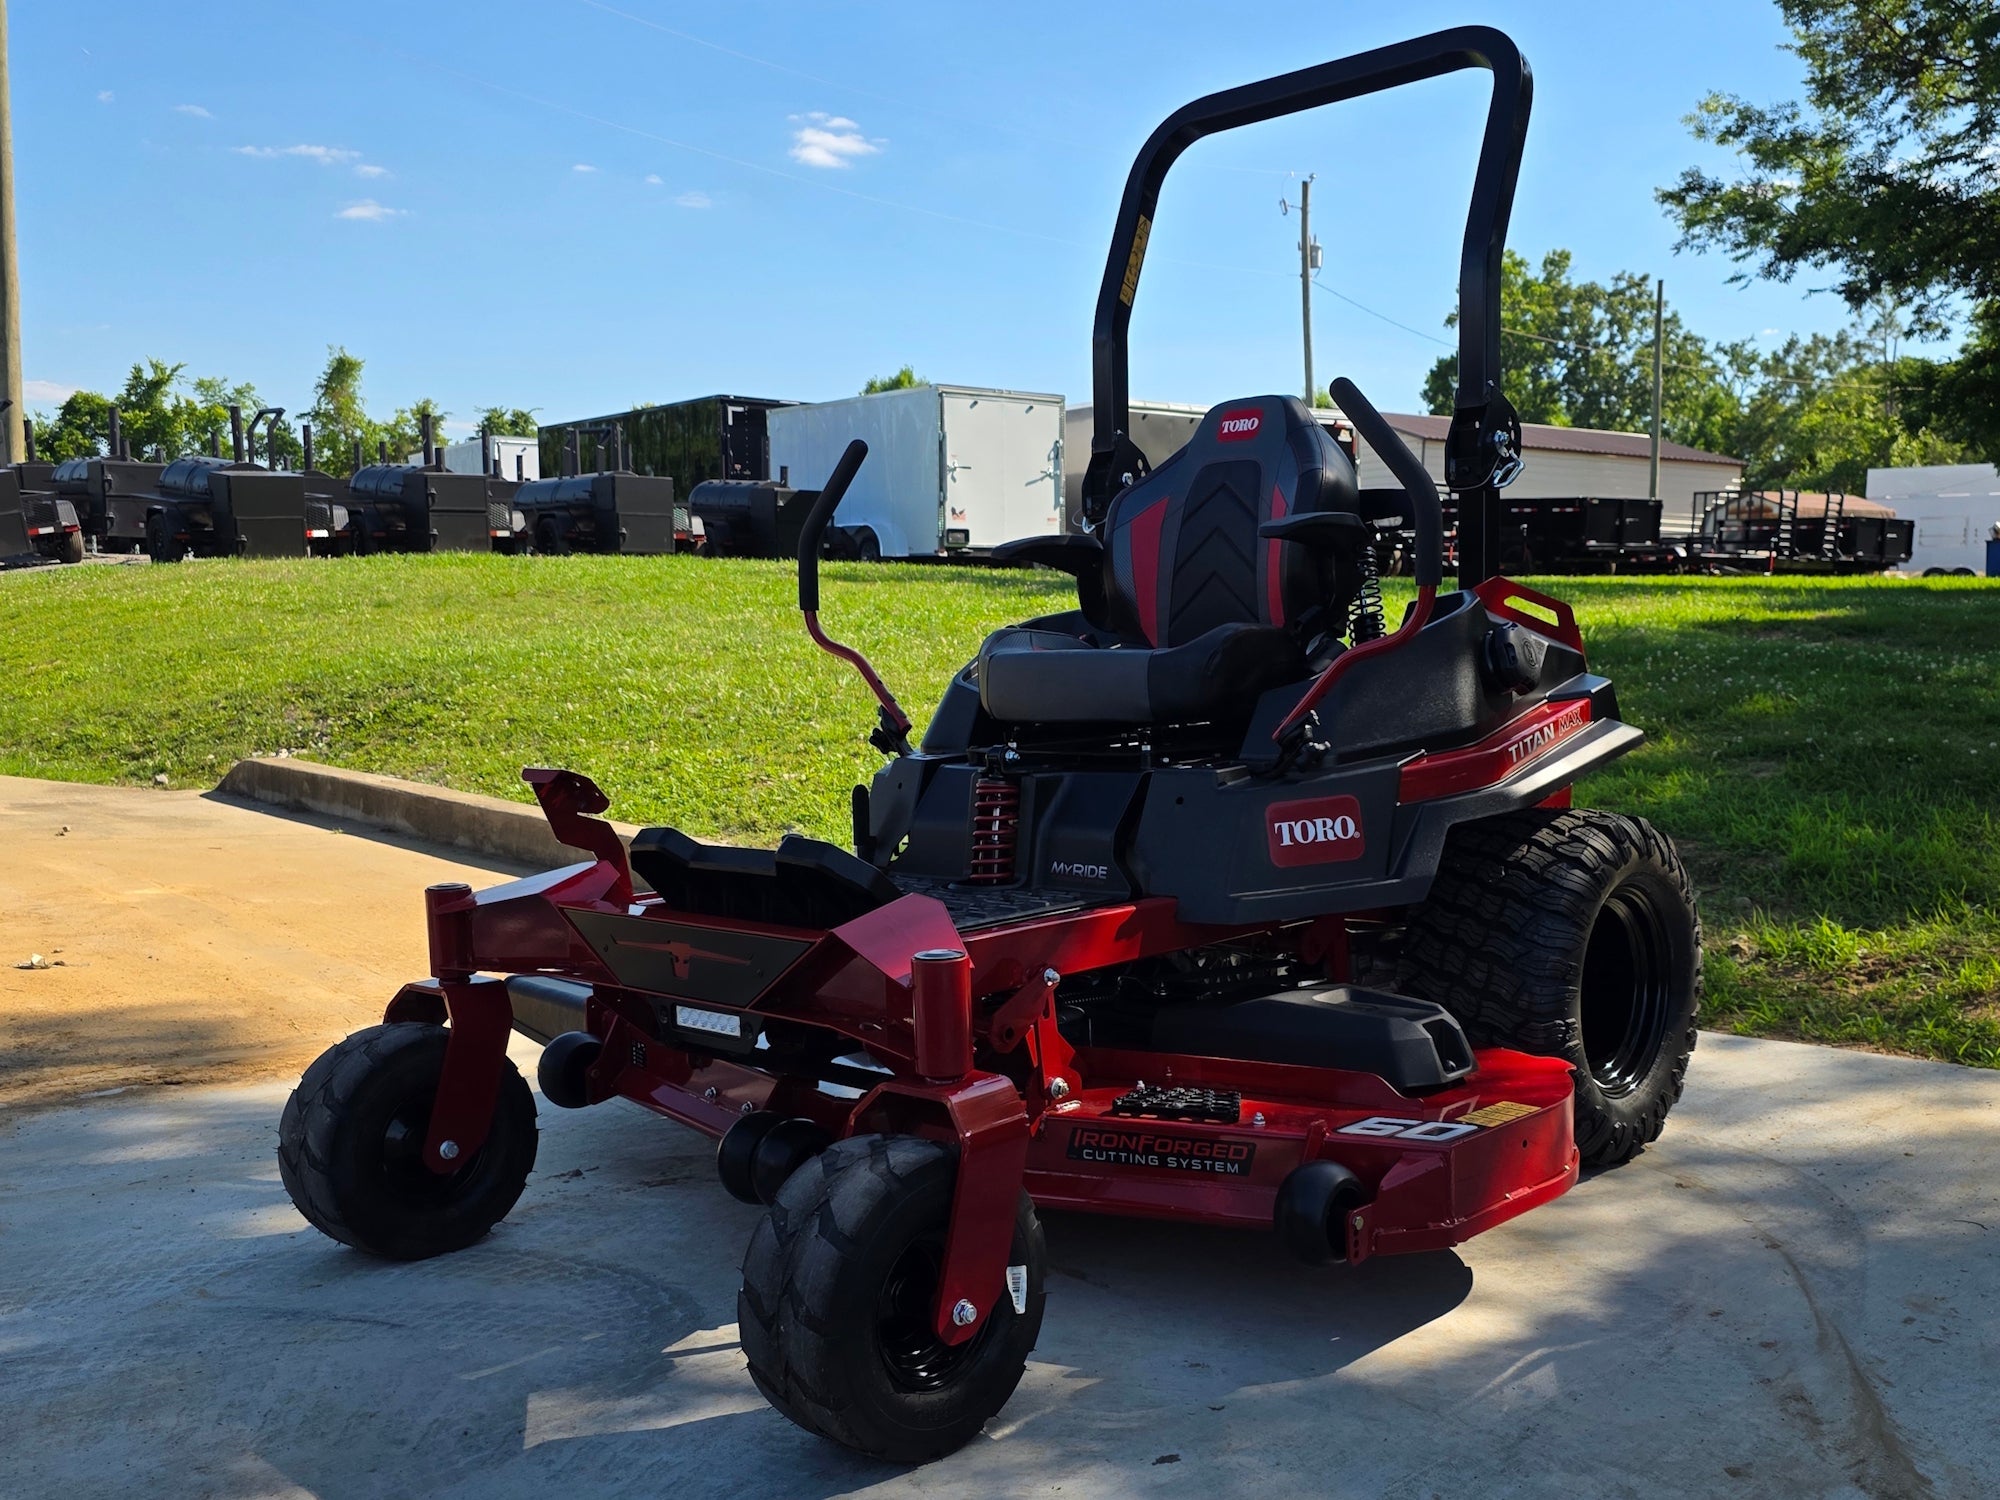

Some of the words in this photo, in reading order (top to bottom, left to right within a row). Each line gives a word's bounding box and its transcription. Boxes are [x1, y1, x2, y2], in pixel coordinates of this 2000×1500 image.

[1221, 417, 1260, 434] TORO
[1508, 722, 1556, 763] TITAN
[1558, 707, 1584, 737] MAX
[1273, 815, 1357, 847] TORO
[1335, 1116, 1479, 1141] 60
[1082, 1149, 1159, 1166] CUTTING
[1167, 1157, 1240, 1174] SYSTEM
